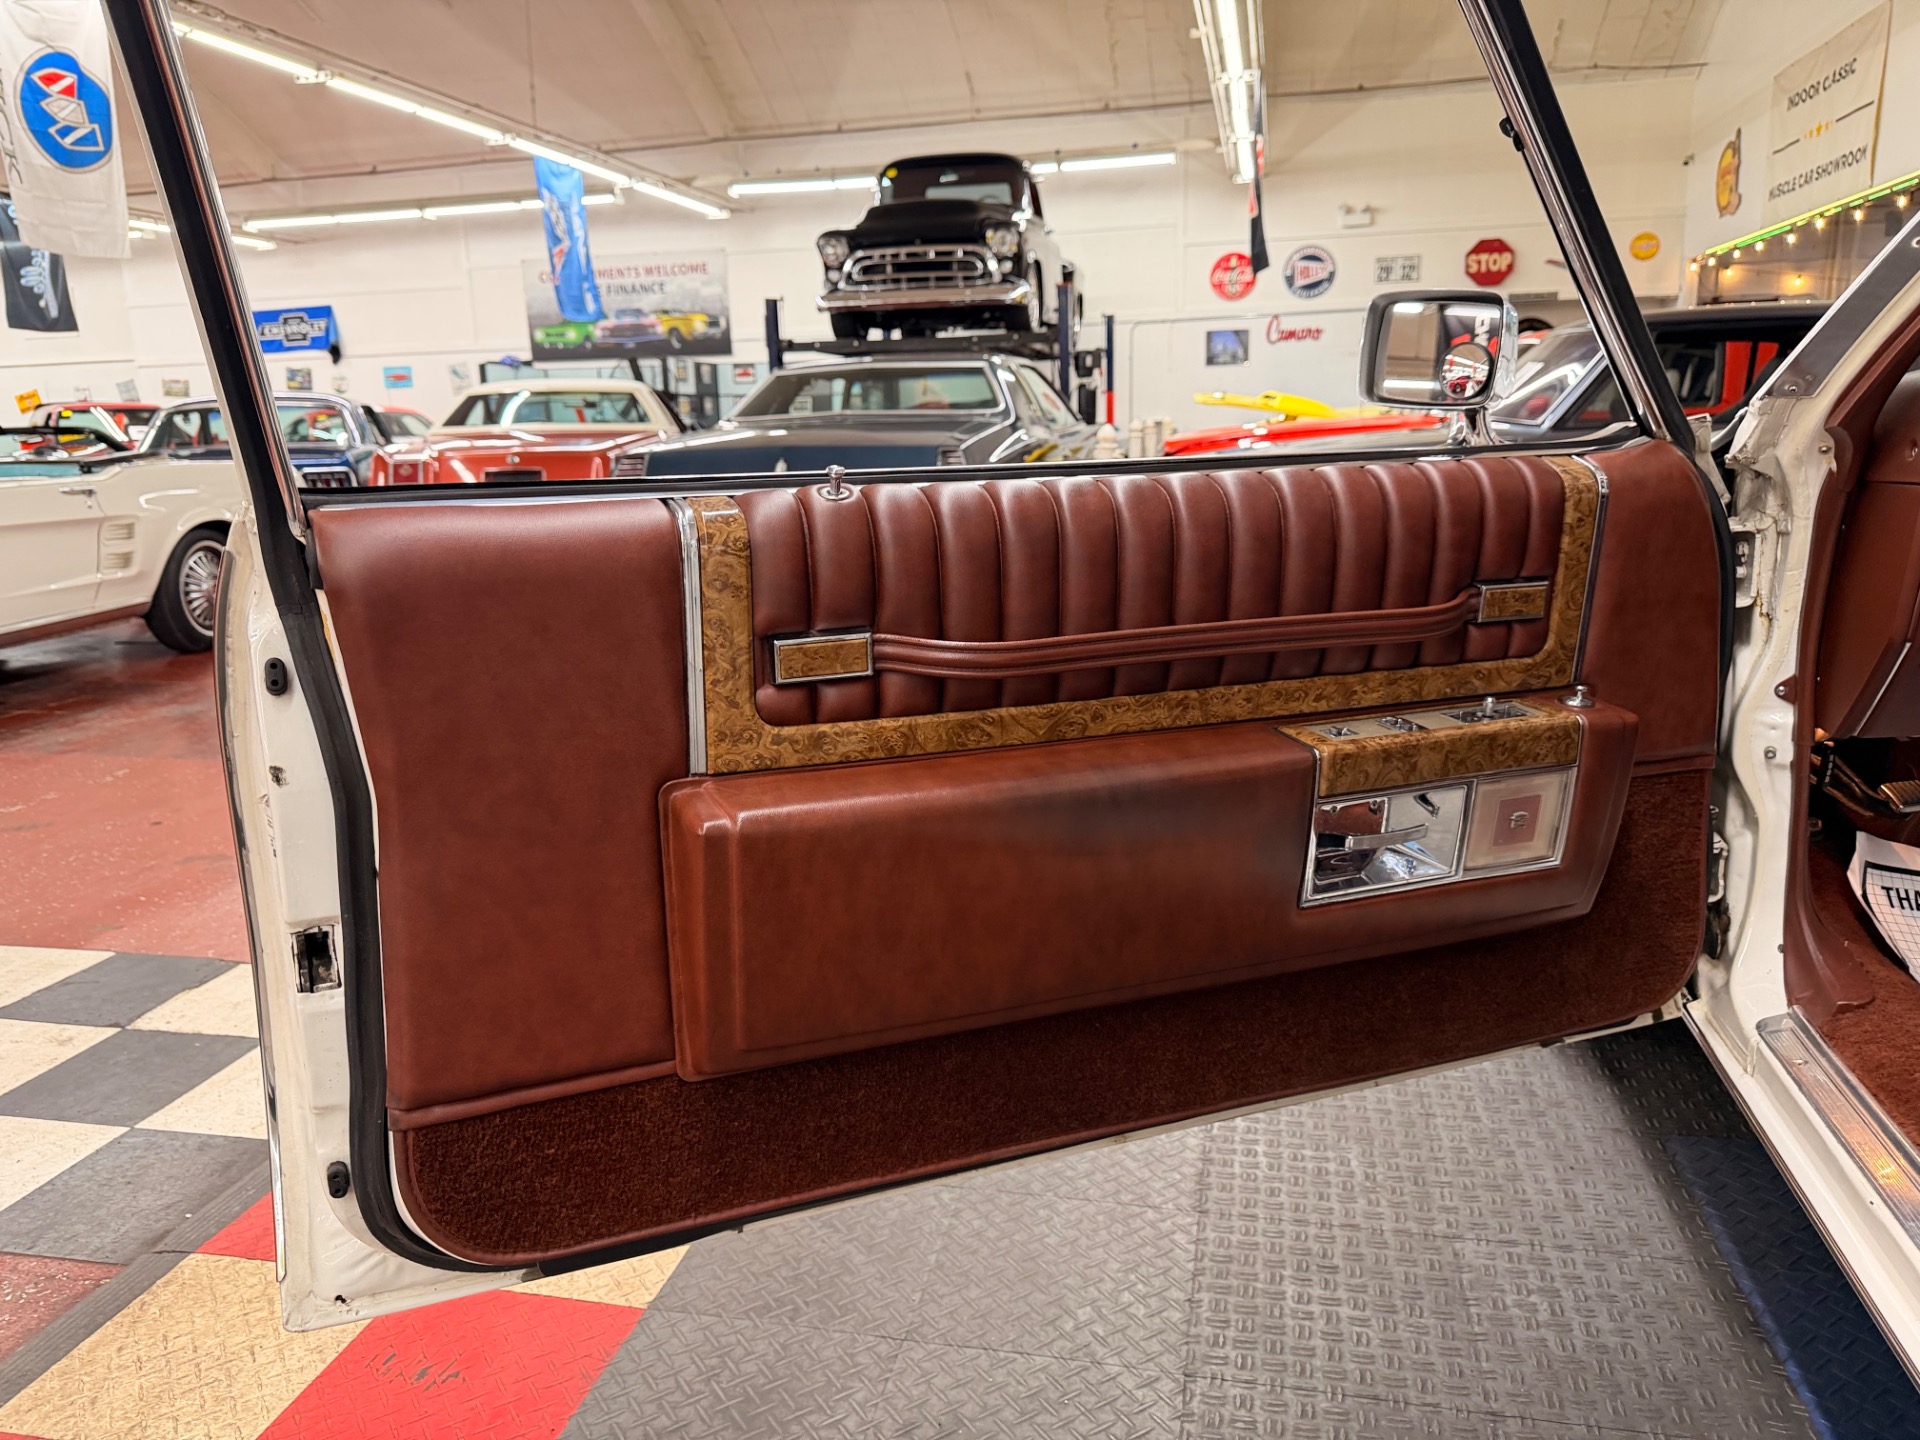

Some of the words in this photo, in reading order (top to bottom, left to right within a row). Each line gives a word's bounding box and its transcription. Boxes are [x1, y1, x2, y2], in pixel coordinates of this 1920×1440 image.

[1787, 80, 1821, 112] INDOOR
[1822, 57, 1858, 92] CLASSIC
[1798, 167, 1815, 190] CAR
[1815, 143, 1869, 182] SHOWROOM
[645, 263, 708, 276] WELCOME
[1468, 251, 1512, 273] STOP
[607, 284, 665, 297] FINANCE
[1266, 314, 1324, 345] Camaro
